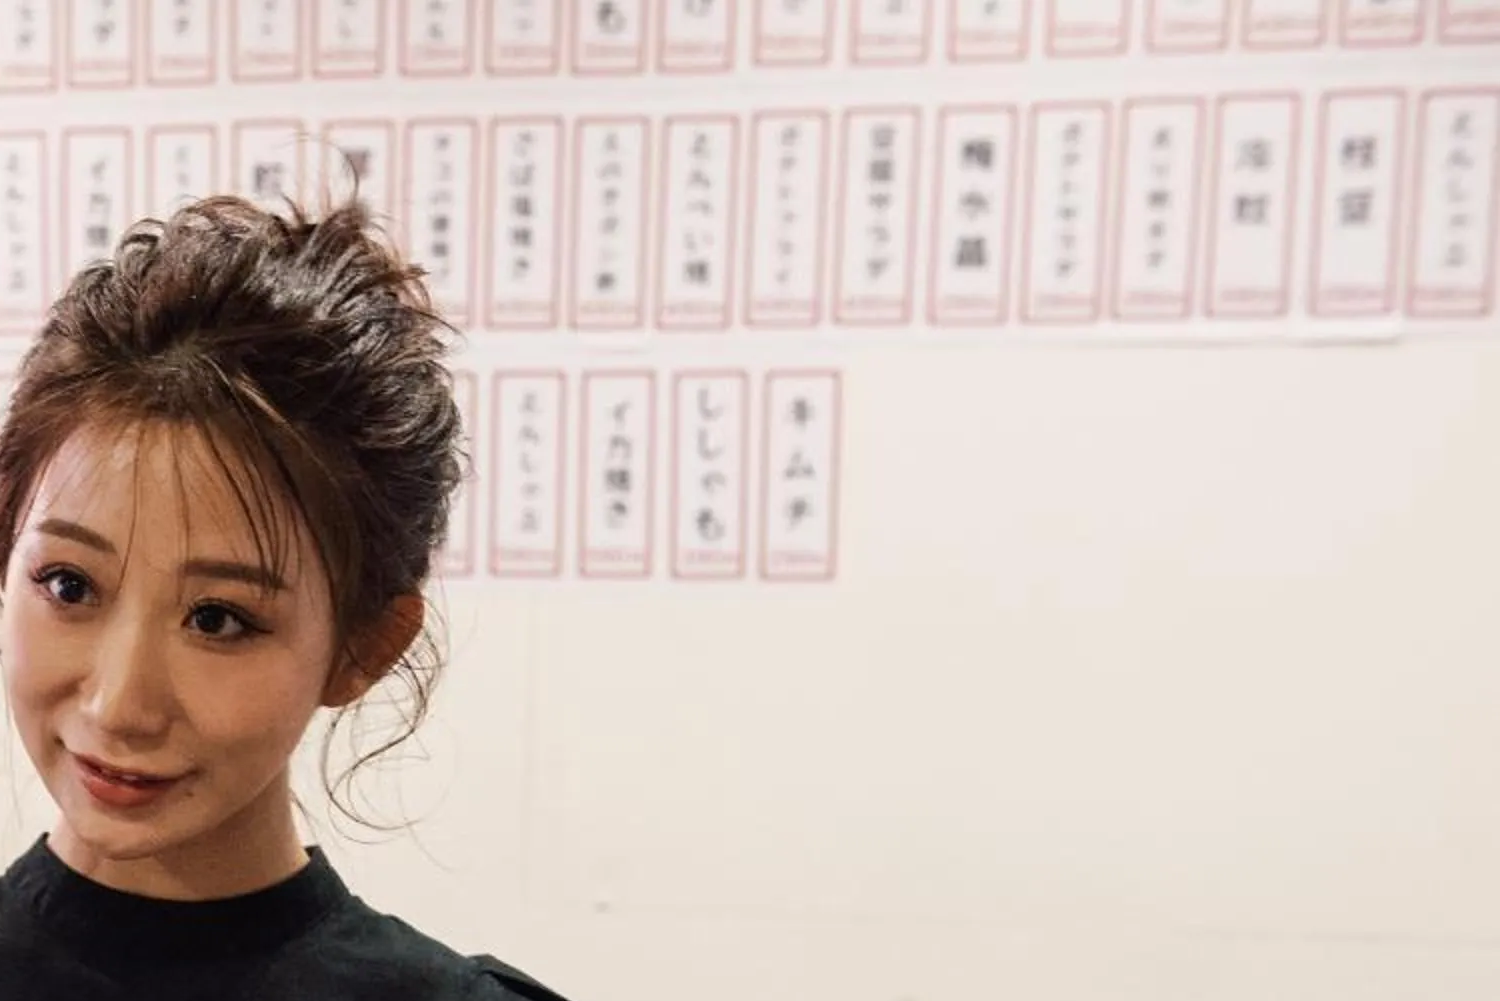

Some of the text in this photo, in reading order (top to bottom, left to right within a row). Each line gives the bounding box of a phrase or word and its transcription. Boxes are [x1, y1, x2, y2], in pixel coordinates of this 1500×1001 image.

[694, 387, 727, 544] ししゃも
[782, 396, 817, 532] キムチ
